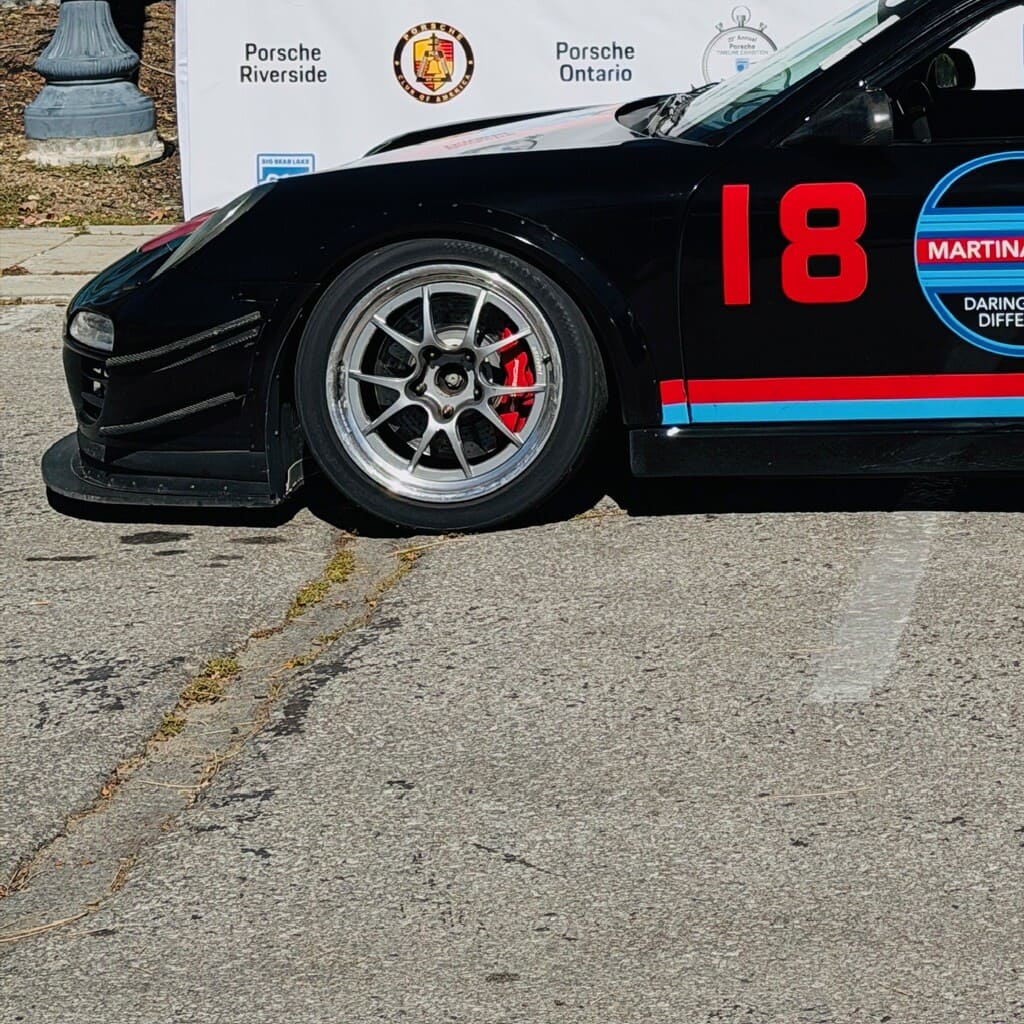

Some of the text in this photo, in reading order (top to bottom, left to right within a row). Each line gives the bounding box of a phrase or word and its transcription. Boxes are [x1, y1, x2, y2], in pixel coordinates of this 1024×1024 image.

[403, 23, 463, 41] PORSCHE
[246, 43, 321, 61] Porsche
[557, 42, 634, 59] Porsche
[241, 66, 326, 82] Riverside
[560, 64, 632, 81] Ontario
[397, 75, 416, 99] CLUB
[436, 74, 471, 102] AMERICA
[721, 182, 868, 305] 18
